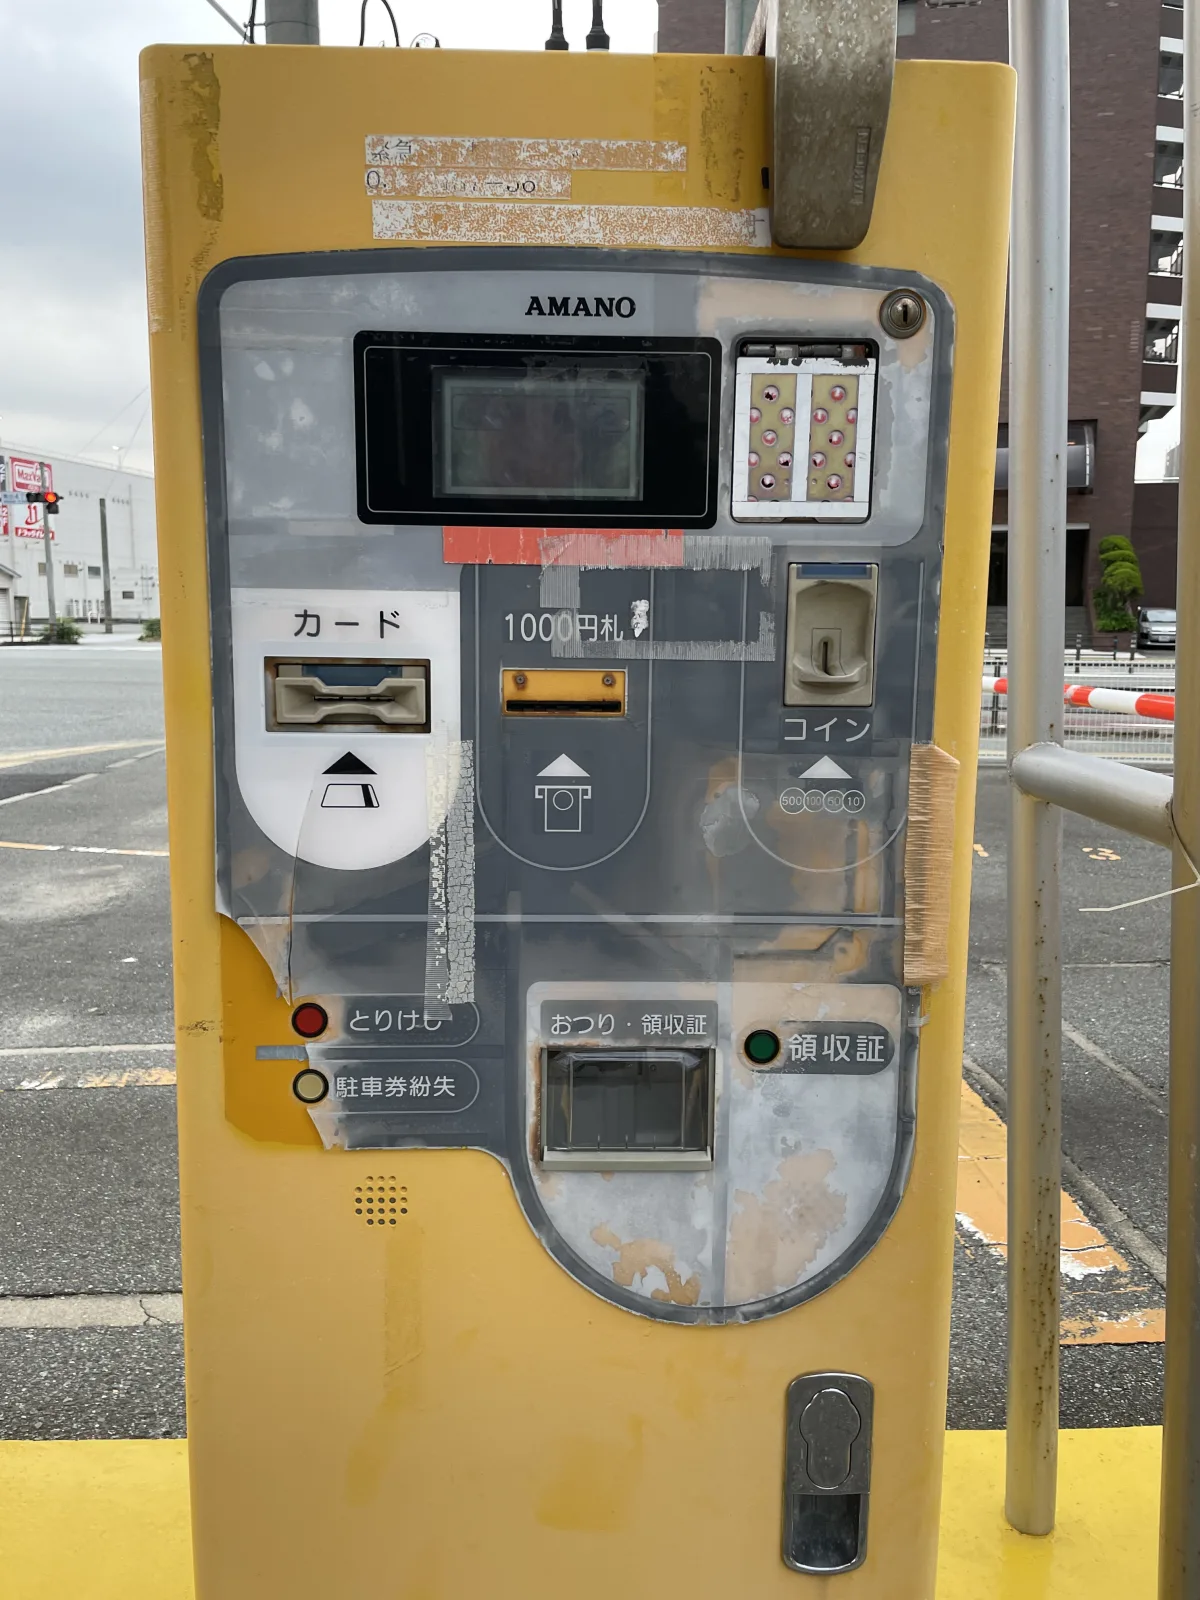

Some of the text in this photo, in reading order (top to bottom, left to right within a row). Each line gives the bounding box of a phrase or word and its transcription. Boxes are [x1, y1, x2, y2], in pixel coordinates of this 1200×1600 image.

[525, 296, 636, 318] AMANO
[294, 609, 400, 638] カード
[505, 613, 624, 642] 1000円札
[784, 717, 870, 742] コイン
[782, 796, 803, 806] 500
[806, 796, 821, 806] 100
[847, 797, 860, 807] 10
[350, 1009, 442, 1032] とりけし
[789, 1033, 886, 1063] 領収証
[336, 1075, 456, 1098] 駐車券紛失
